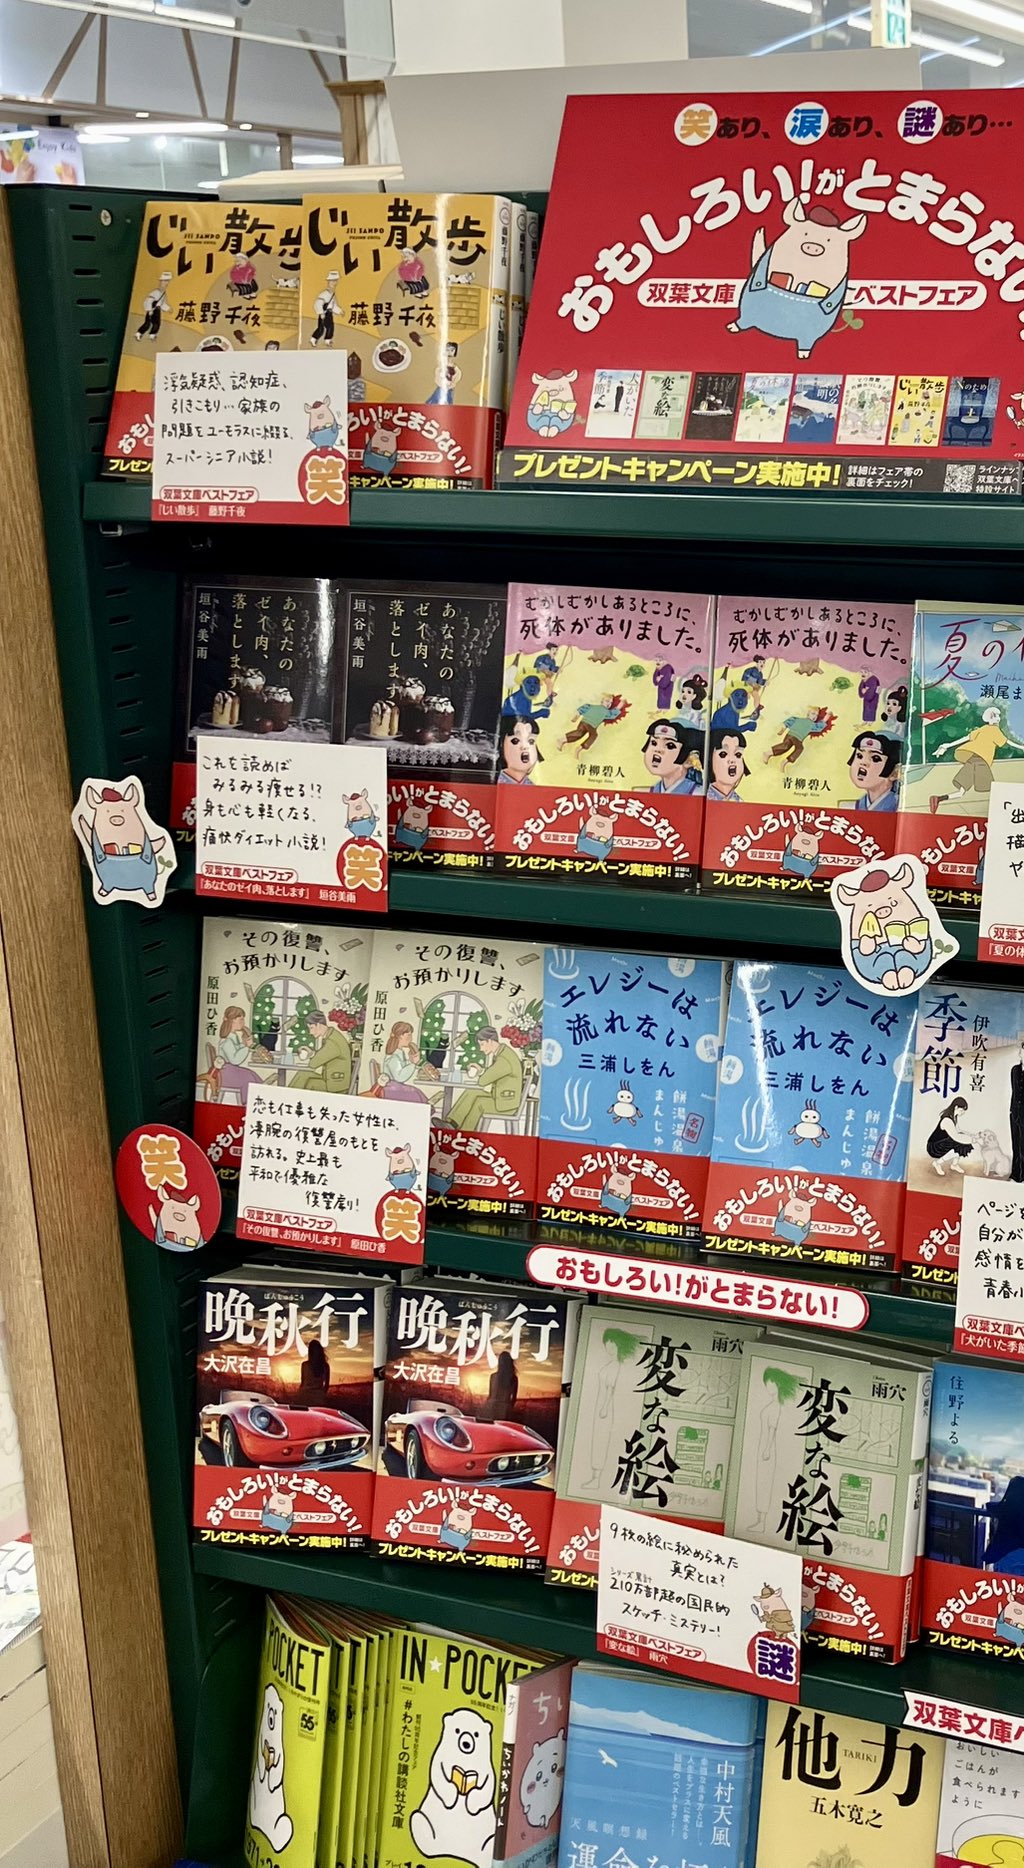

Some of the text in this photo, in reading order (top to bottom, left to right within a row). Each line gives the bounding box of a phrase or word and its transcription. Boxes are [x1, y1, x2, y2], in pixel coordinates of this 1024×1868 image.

[308, 198, 487, 273] じい散歩
[646, 282, 979, 307] 双葉文庫 ベストフェア
[174, 302, 261, 327] 藤野千夜
[307, 457, 345, 503] 笑
[848, 465, 923, 476] 詳細はフェア帯の
[163, 489, 254, 499] 双葉文庫ベストフェア
[197, 592, 211, 660] 垣谷美雨
[525, 595, 696, 626] むかしむかしあるところに、
[229, 594, 246, 690] 落とします
[279, 596, 296, 672] あなたの
[520, 617, 702, 654] 死体がありました。
[203, 755, 292, 771] これを読めば
[576, 764, 625, 778] 青柳碧人
[205, 865, 294, 881] 双葉文庫ベストフェア
[223, 953, 349, 981] お預かりします
[205, 975, 220, 1037] 原田ひ香
[559, 966, 699, 1020] エレジーは
[566, 1009, 690, 1049] 流れない
[919, 992, 968, 1099] 季節
[578, 1054, 675, 1078] 三浦しをん
[969, 1014, 991, 1094] 伊吹有喜
[138, 1135, 187, 1190] 笑
[249, 1165, 328, 1186] 平和で優雅な
[204, 1288, 368, 1357] 晩秋行
[203, 1355, 272, 1376] 大沢在昌
[872, 1381, 907, 1402] 雨穴
[611, 1335, 693, 1508] 変な絵
[947, 1376, 965, 1446] 住野よる
[400, 1635, 427, 1684] IN
[757, 1638, 796, 1683] 謎
[775, 1705, 926, 1808] 他力
[843, 1749, 877, 1763] TARIKI
[954, 1759, 998, 1776] ごはんが
[710, 1759, 736, 1848] 中村天風
[951, 1798, 983, 1810] ように
[952, 1777, 1021, 1799] 食べられます
[808, 1796, 883, 1830] 五木寛之
